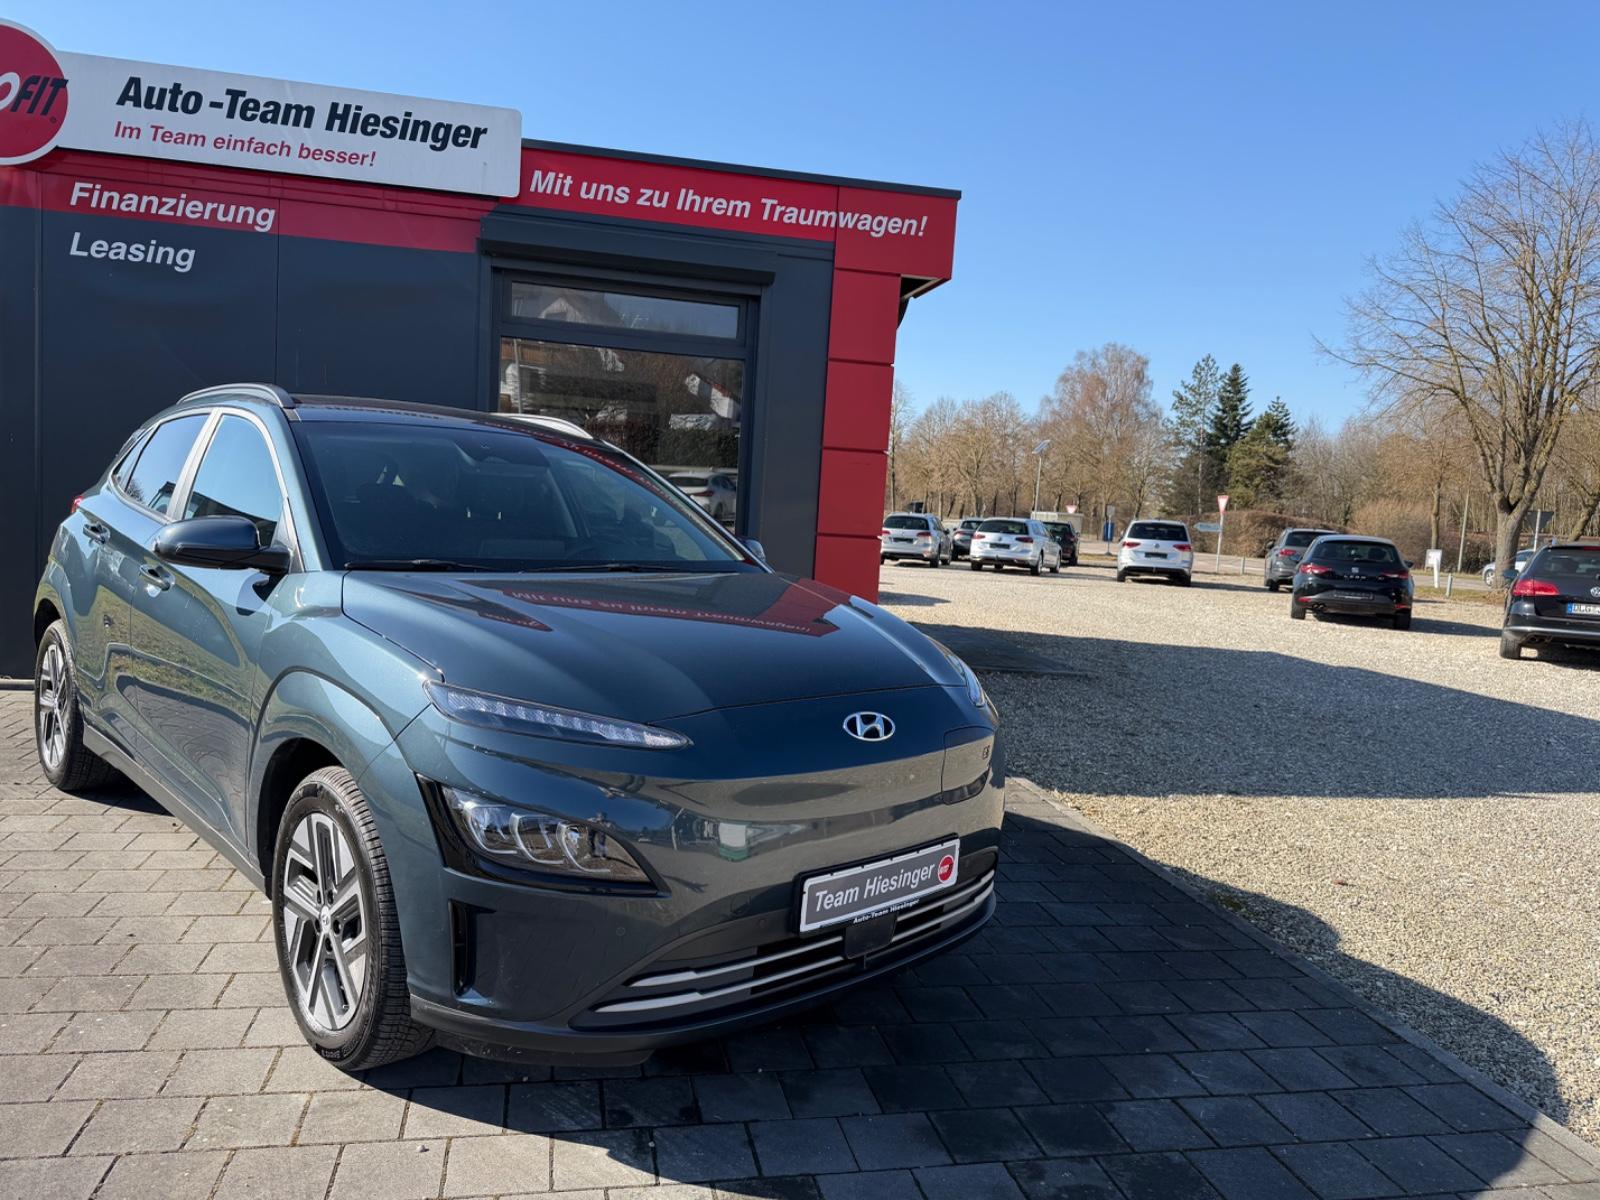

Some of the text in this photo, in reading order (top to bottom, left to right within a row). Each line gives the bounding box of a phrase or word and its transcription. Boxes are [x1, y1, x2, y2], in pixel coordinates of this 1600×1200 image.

[115, 121, 376, 168] Im Team einfach besser!
[325, 101, 488, 152] Hiesinger
[70, 182, 276, 233] Finanzierung
[529, 169, 928, 238] Mit uns zu Ihrem Traumwagen!
[70, 232, 196, 273] Leasing
[815, 886, 859, 912] Team
[863, 863, 935, 899] Hiesinger
